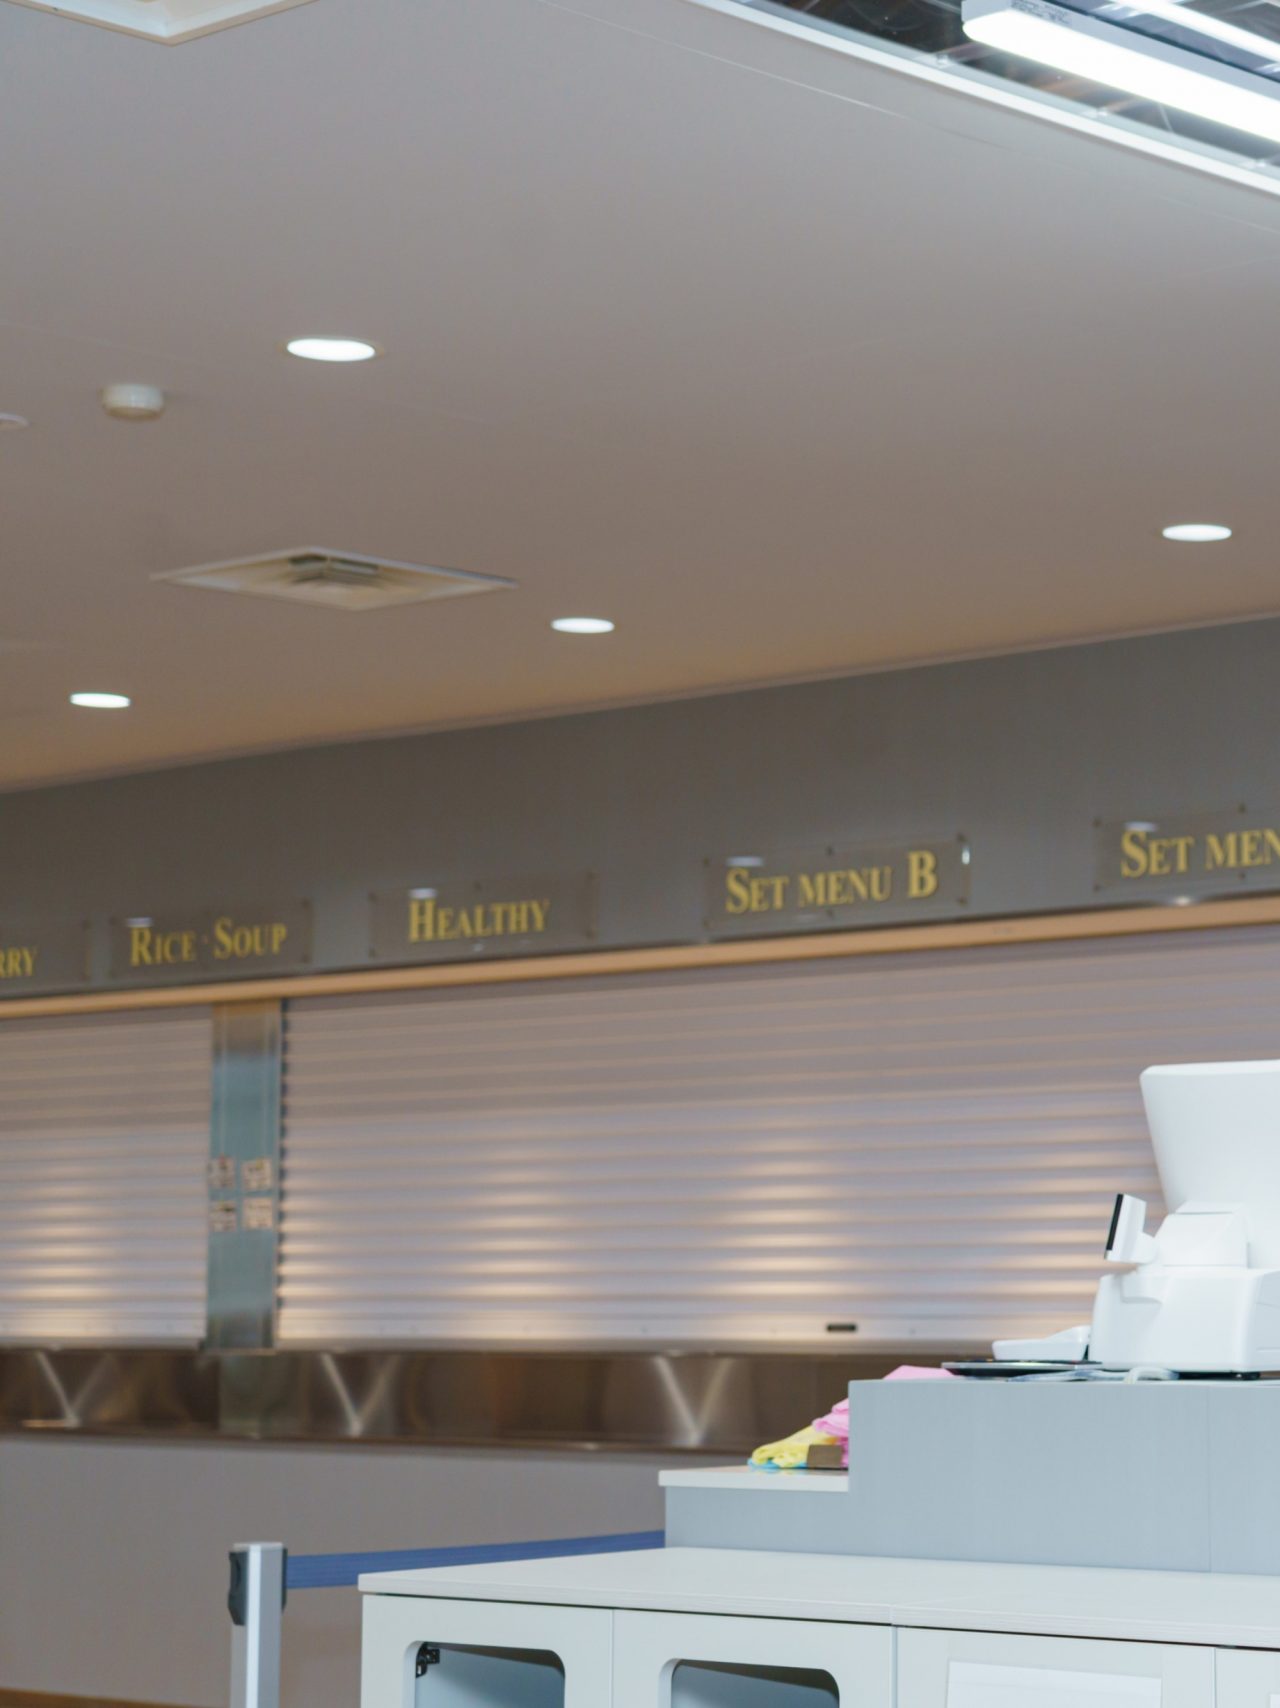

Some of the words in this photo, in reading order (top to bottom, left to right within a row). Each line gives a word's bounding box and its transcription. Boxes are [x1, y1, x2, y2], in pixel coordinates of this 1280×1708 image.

[1119, 829, 1195, 879] SET
[724, 866, 791, 914] SET
[799, 865, 894, 908] MENU
[907, 850, 940, 900] B
[128, 926, 196, 968] RICE
[212, 915, 287, 961] SOUP
[407, 898, 551, 944] HEALTHY
